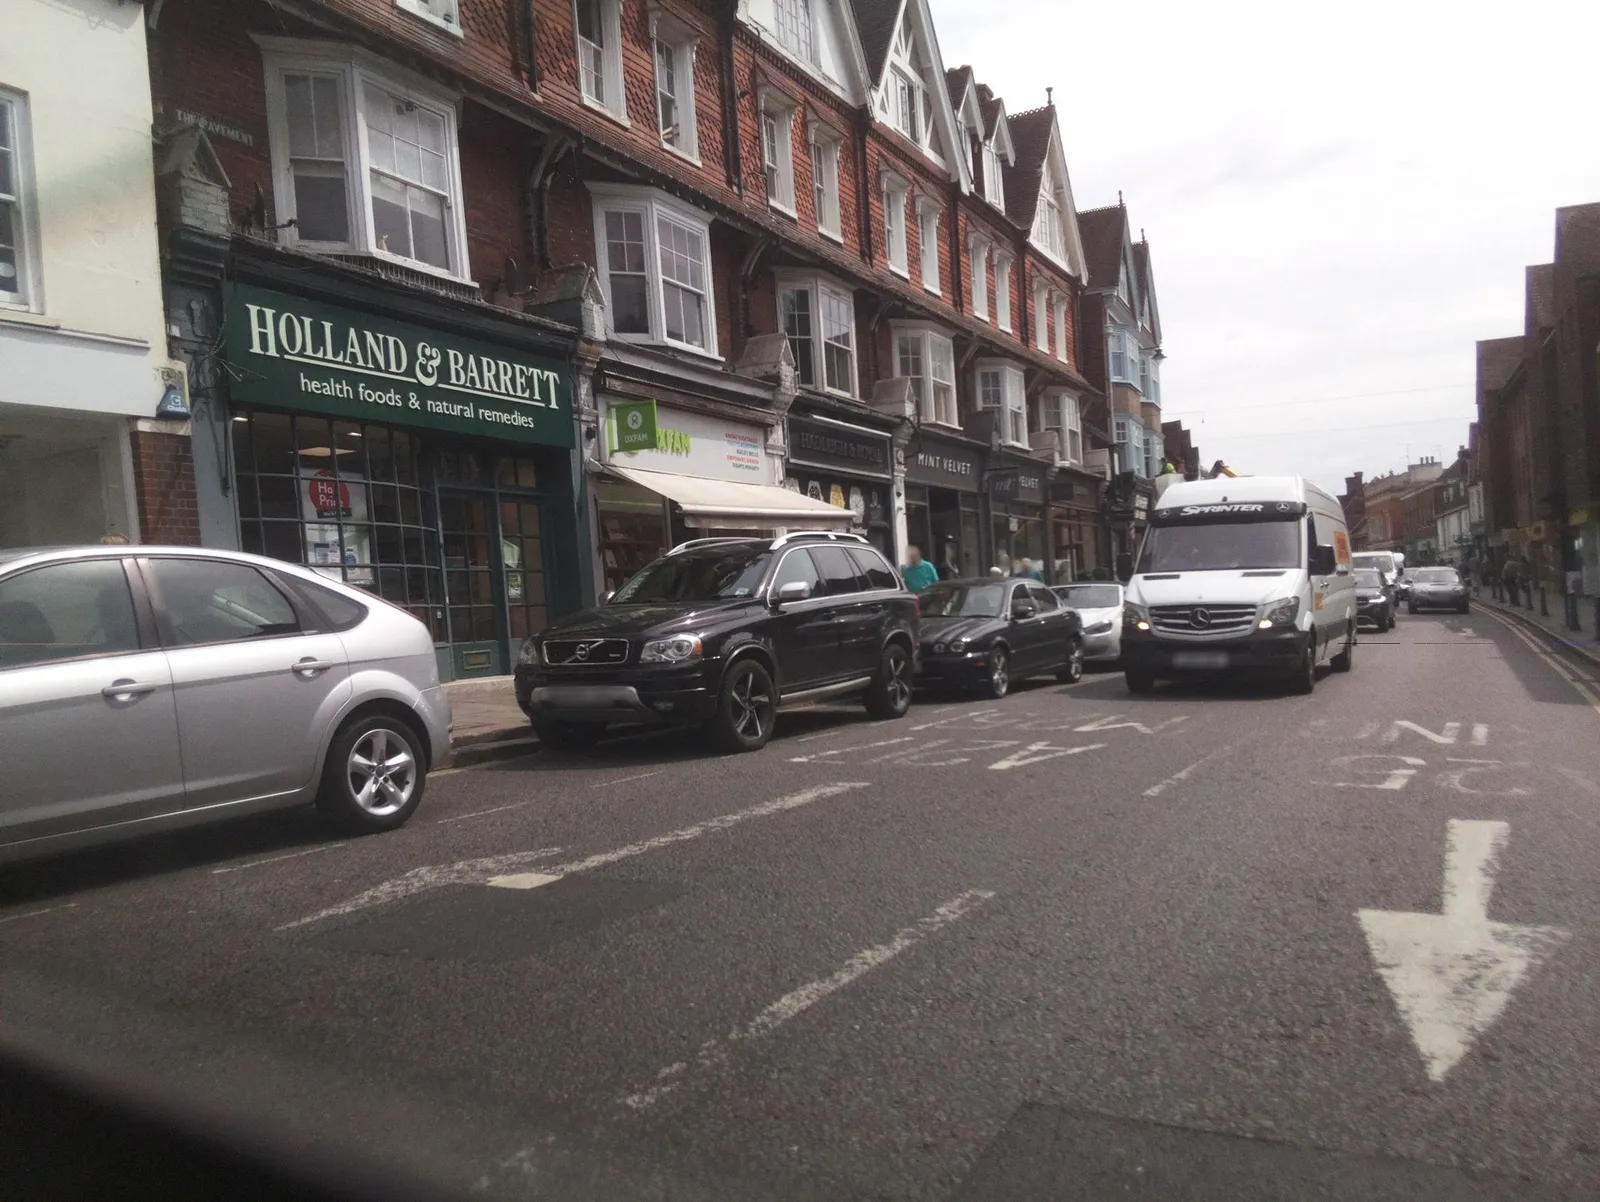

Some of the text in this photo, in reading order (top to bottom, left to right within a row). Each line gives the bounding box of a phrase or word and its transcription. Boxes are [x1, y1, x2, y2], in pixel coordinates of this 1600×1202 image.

[198, 116, 254, 147] AVEMENT
[245, 303, 560, 409] HOLLAND & BARRETT
[300, 373, 535, 429] health foods & natural remedies
[624, 432, 648, 443] OXFAM
[657, 427, 692, 457] XFAM
[917, 453, 971, 475] MINT VELVET
[1180, 504, 1264, 516] SPRINTER
